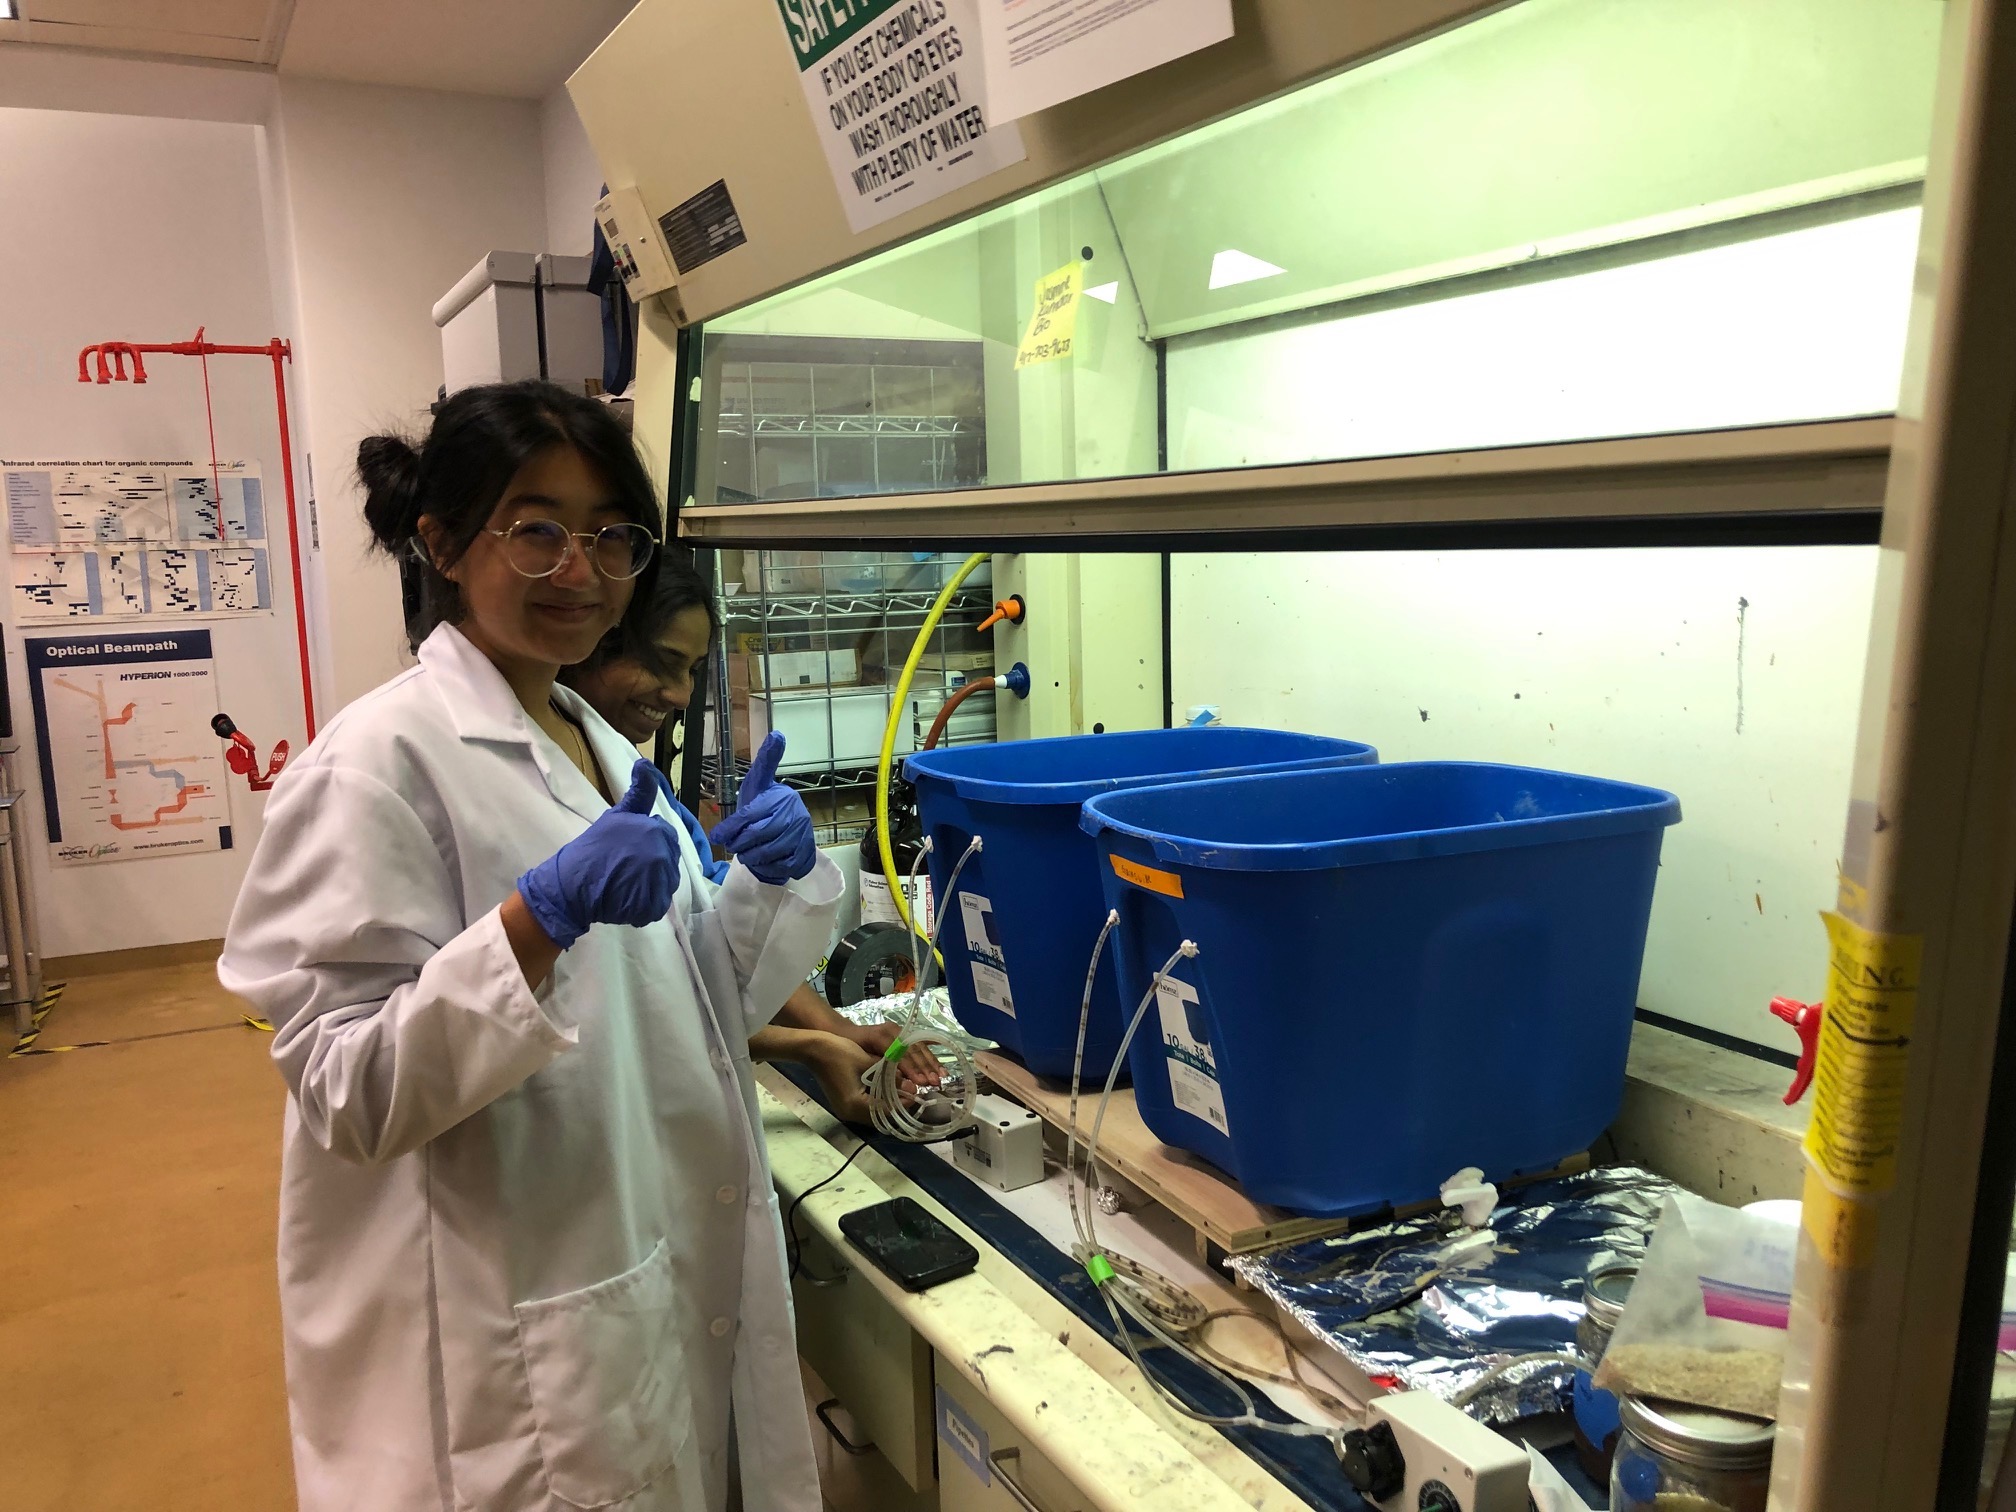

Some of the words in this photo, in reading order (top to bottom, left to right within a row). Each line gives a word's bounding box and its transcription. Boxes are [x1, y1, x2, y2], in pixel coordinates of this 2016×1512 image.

[784, 0, 868, 54] SAF
[820, 67, 833, 97] IF
[831, 51, 857, 89] YOU
[854, 36, 879, 74] GET
[876, 0, 947, 59] CHEMICALS
[829, 102, 849, 131] ON
[845, 81, 879, 121] YOUR
[873, 59, 909, 103] BODY
[906, 48, 930, 83] OR
[925, 25, 964, 72] EYES
[848, 123, 885, 159] WASH
[879, 71, 962, 142] THOROUGHLY
[851, 162, 882, 196] WITH
[877, 137, 922, 184] PLENTY
[919, 128, 939, 162] OF
[935, 104, 988, 153] WATER
[117, 460, 148, 469] organic
[149, 460, 194, 468] compounds
[46, 644, 100, 658] Optical
[104, 640, 178, 654] Beampath
[120, 671, 172, 681] HYPERION
[271, 752, 286, 762] PUSH
[970, 940, 980, 953] 10
[1166, 1033, 1180, 1048] 10
[1193, 1044, 1205, 1060] 38
